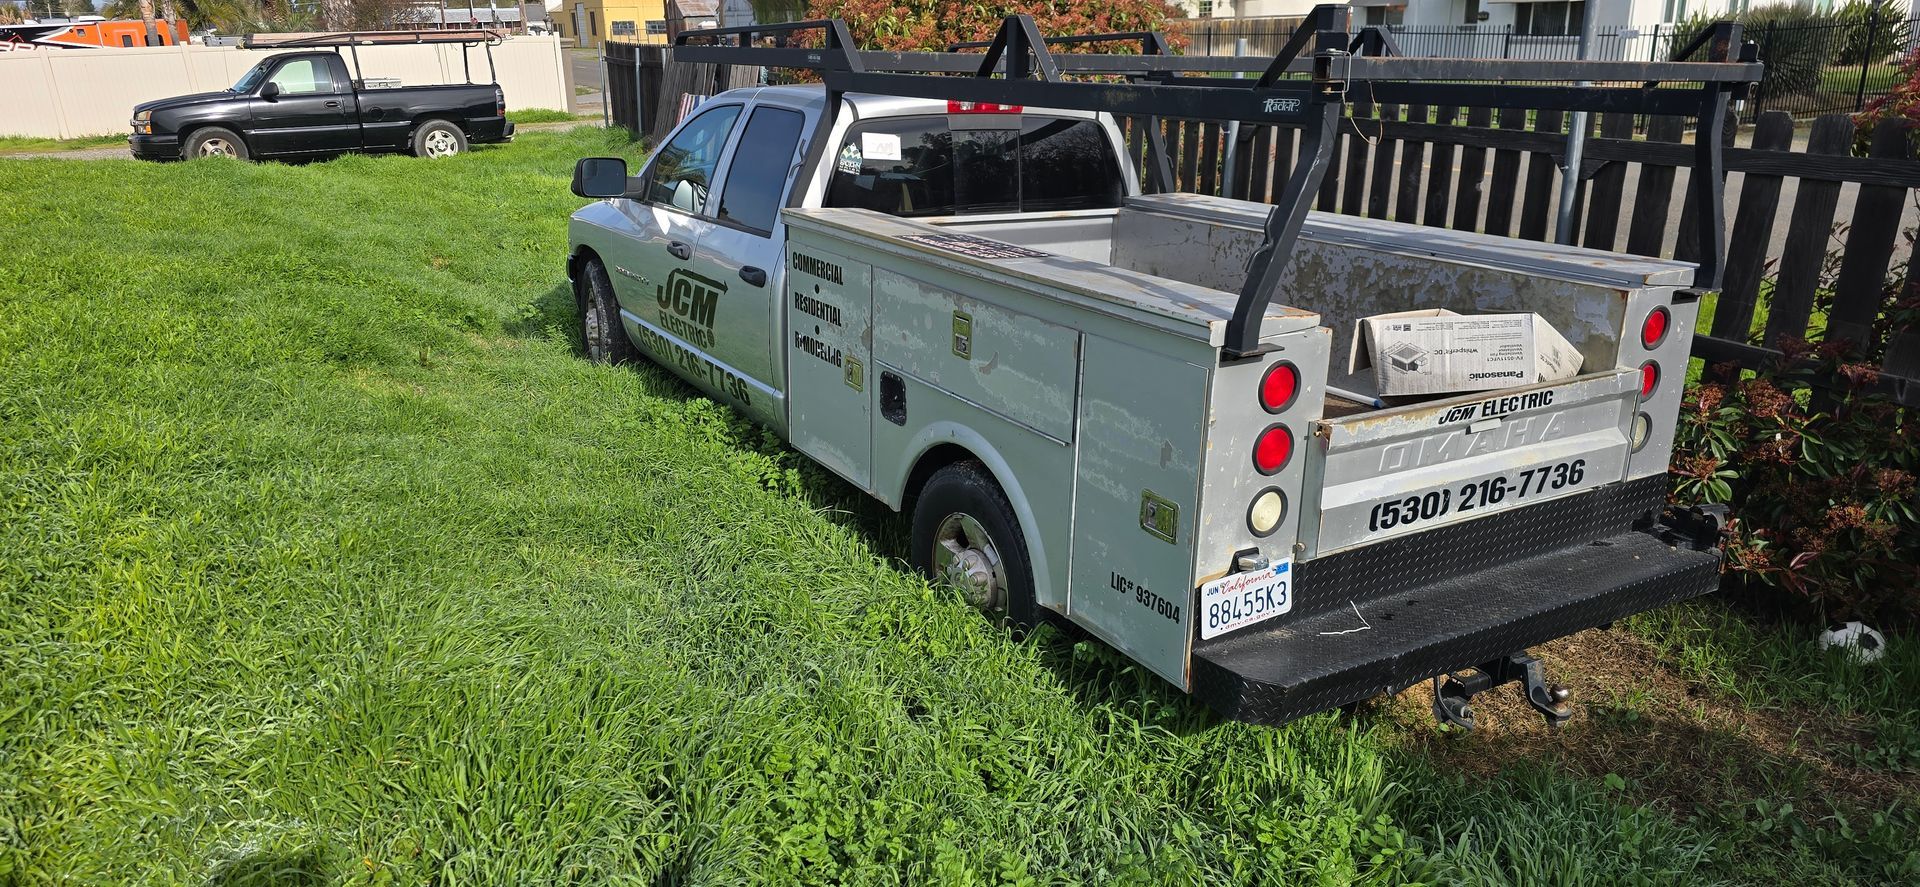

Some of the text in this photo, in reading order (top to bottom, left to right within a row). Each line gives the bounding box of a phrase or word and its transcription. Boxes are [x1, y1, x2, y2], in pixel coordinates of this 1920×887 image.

[793, 251, 843, 286] COMMERCIAL
[657, 268, 719, 329] JCM
[794, 292, 842, 327] RESIDENTIAL
[658, 310, 708, 349] ELECTRIC
[638, 324, 751, 406] (530) 216-7736
[1469, 371, 1524, 381] Panasonic
[1438, 390, 1554, 425] JCM ELECTRIC
[1378, 411, 1566, 472] OMAHA
[1368, 459, 1586, 532] (530) 216-7736
[1111, 571, 1180, 624] LIC# 937604
[1207, 570, 1276, 596] JUN California
[1209, 581, 1287, 628] 88455K3
[1225, 611, 1271, 630] dmv.ca.gov
